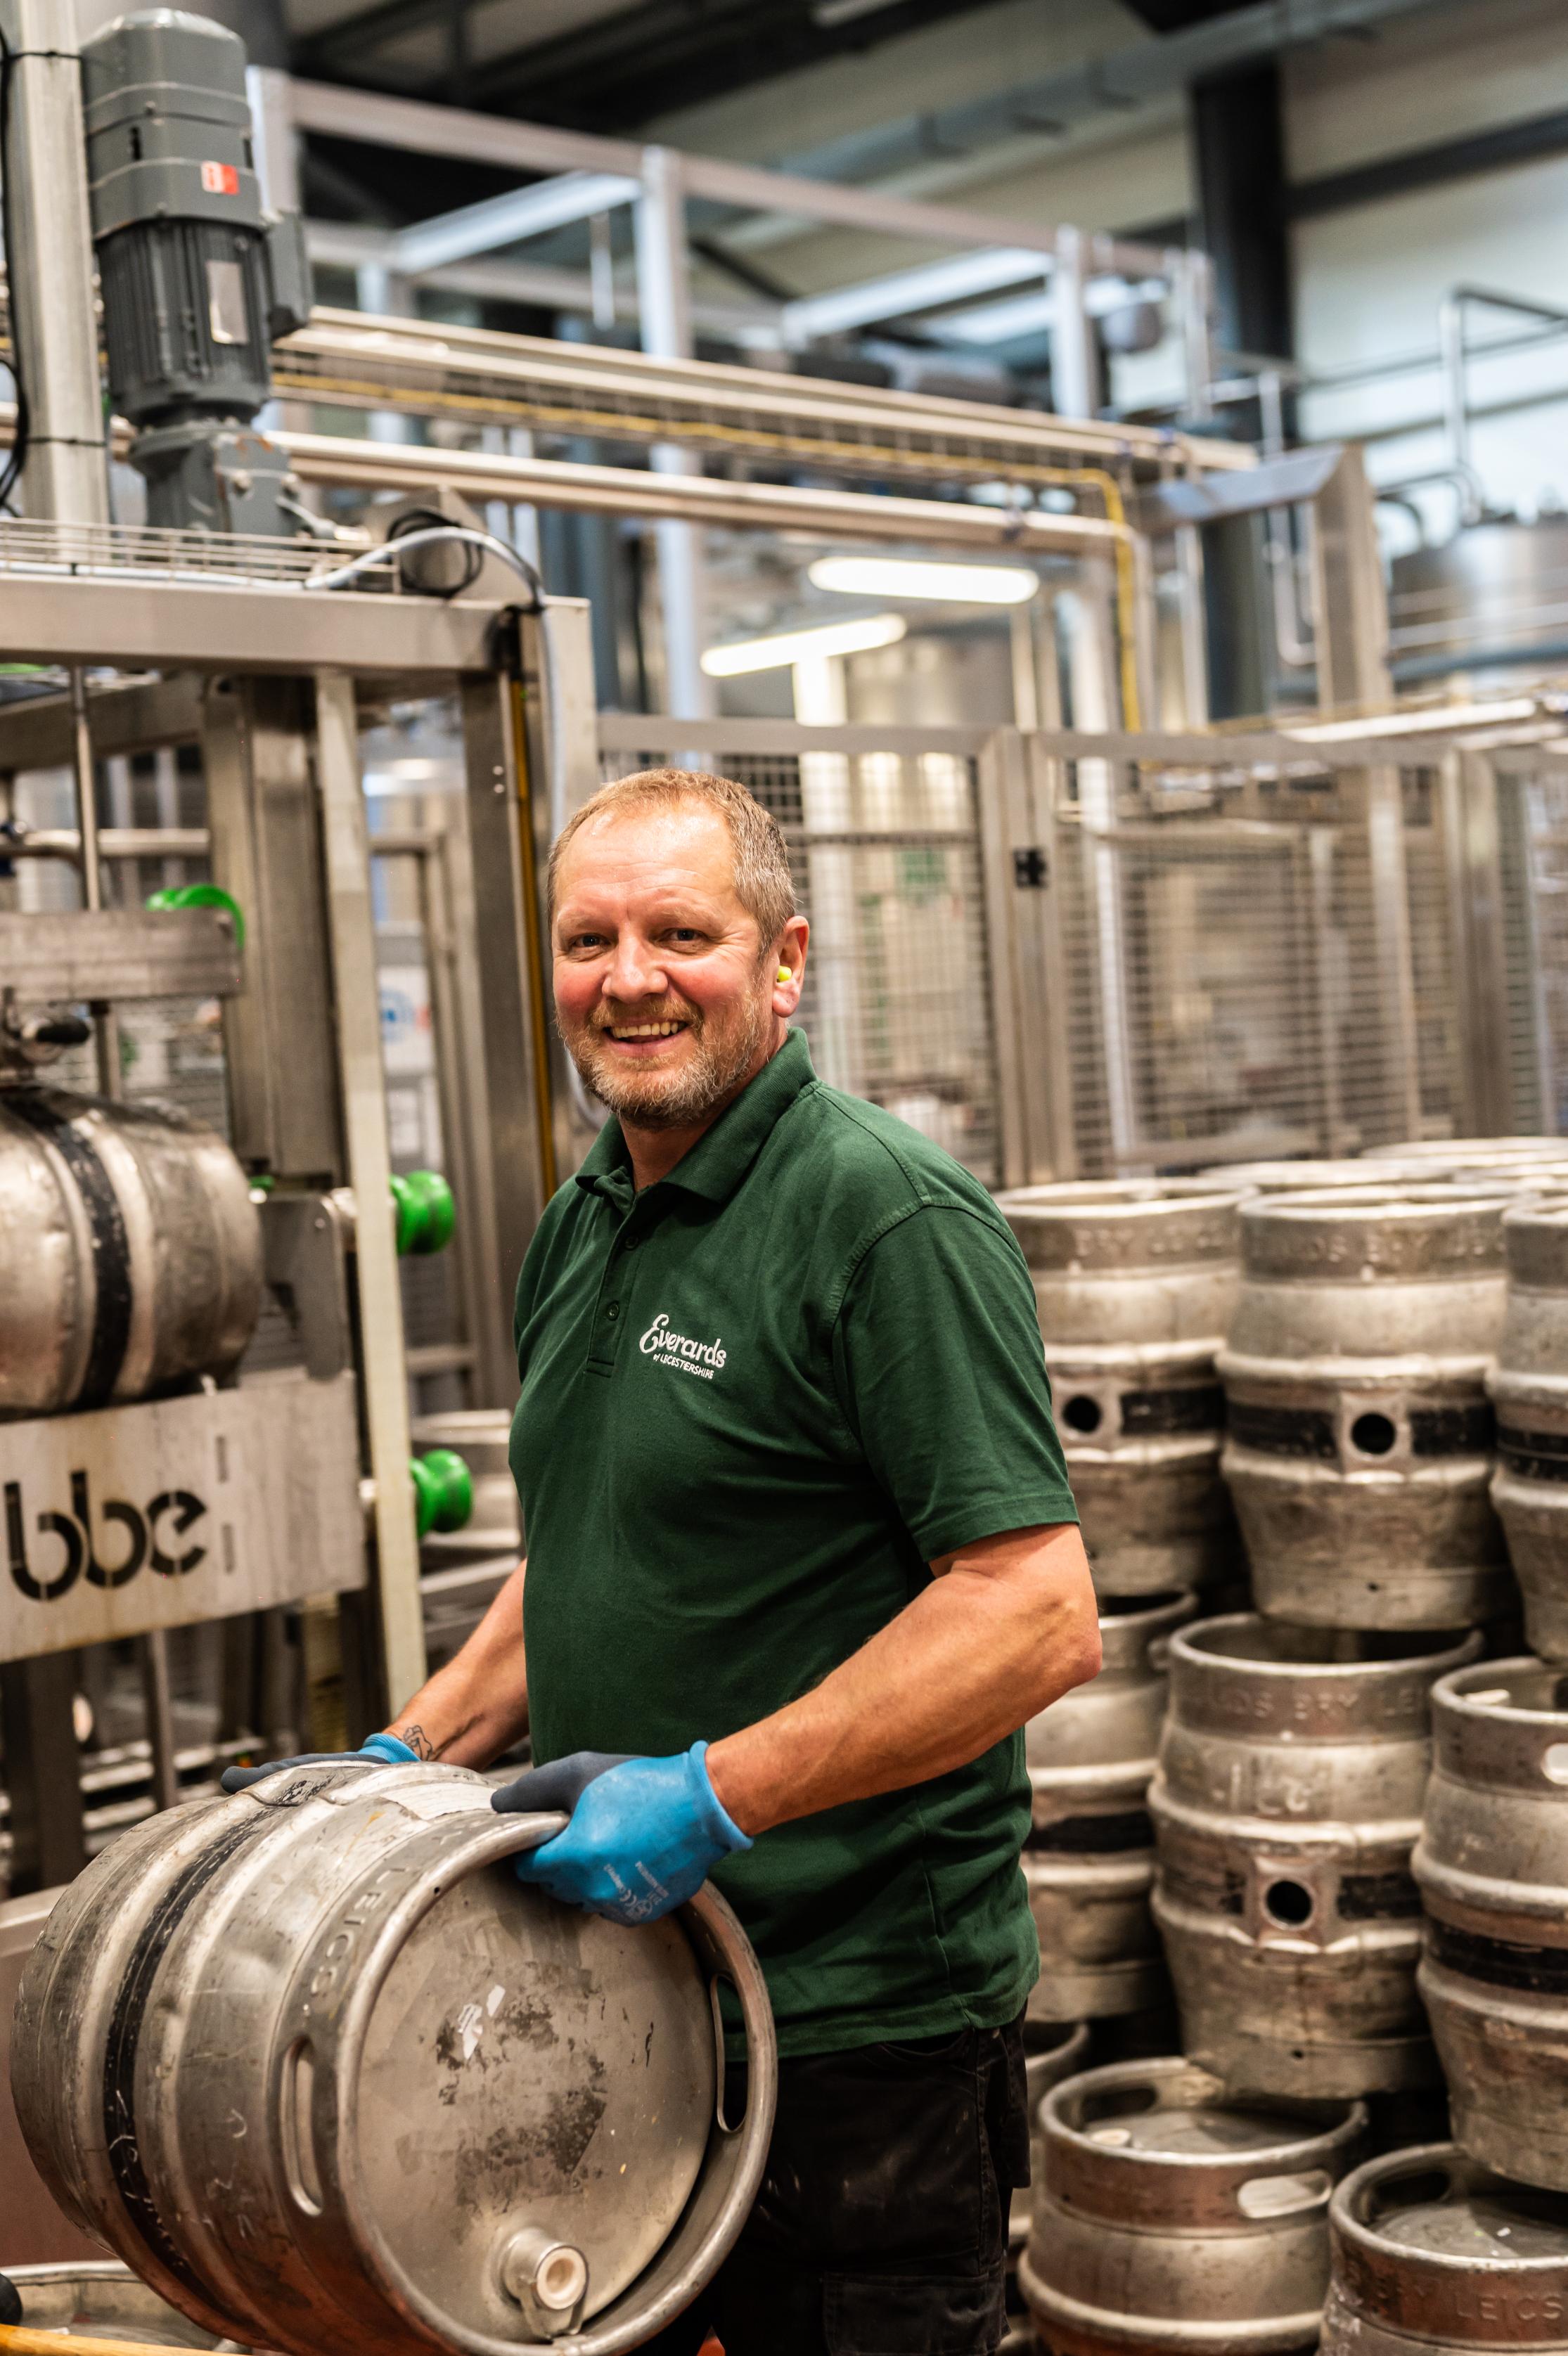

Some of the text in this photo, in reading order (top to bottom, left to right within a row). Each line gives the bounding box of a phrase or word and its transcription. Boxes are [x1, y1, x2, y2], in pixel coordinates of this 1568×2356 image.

[638, 1313, 727, 1368] Everards
[653, 1353, 661, 1362] of
[4, 1469, 207, 1602] bbe
[1456, 2292, 1564, 2320] LEICS
